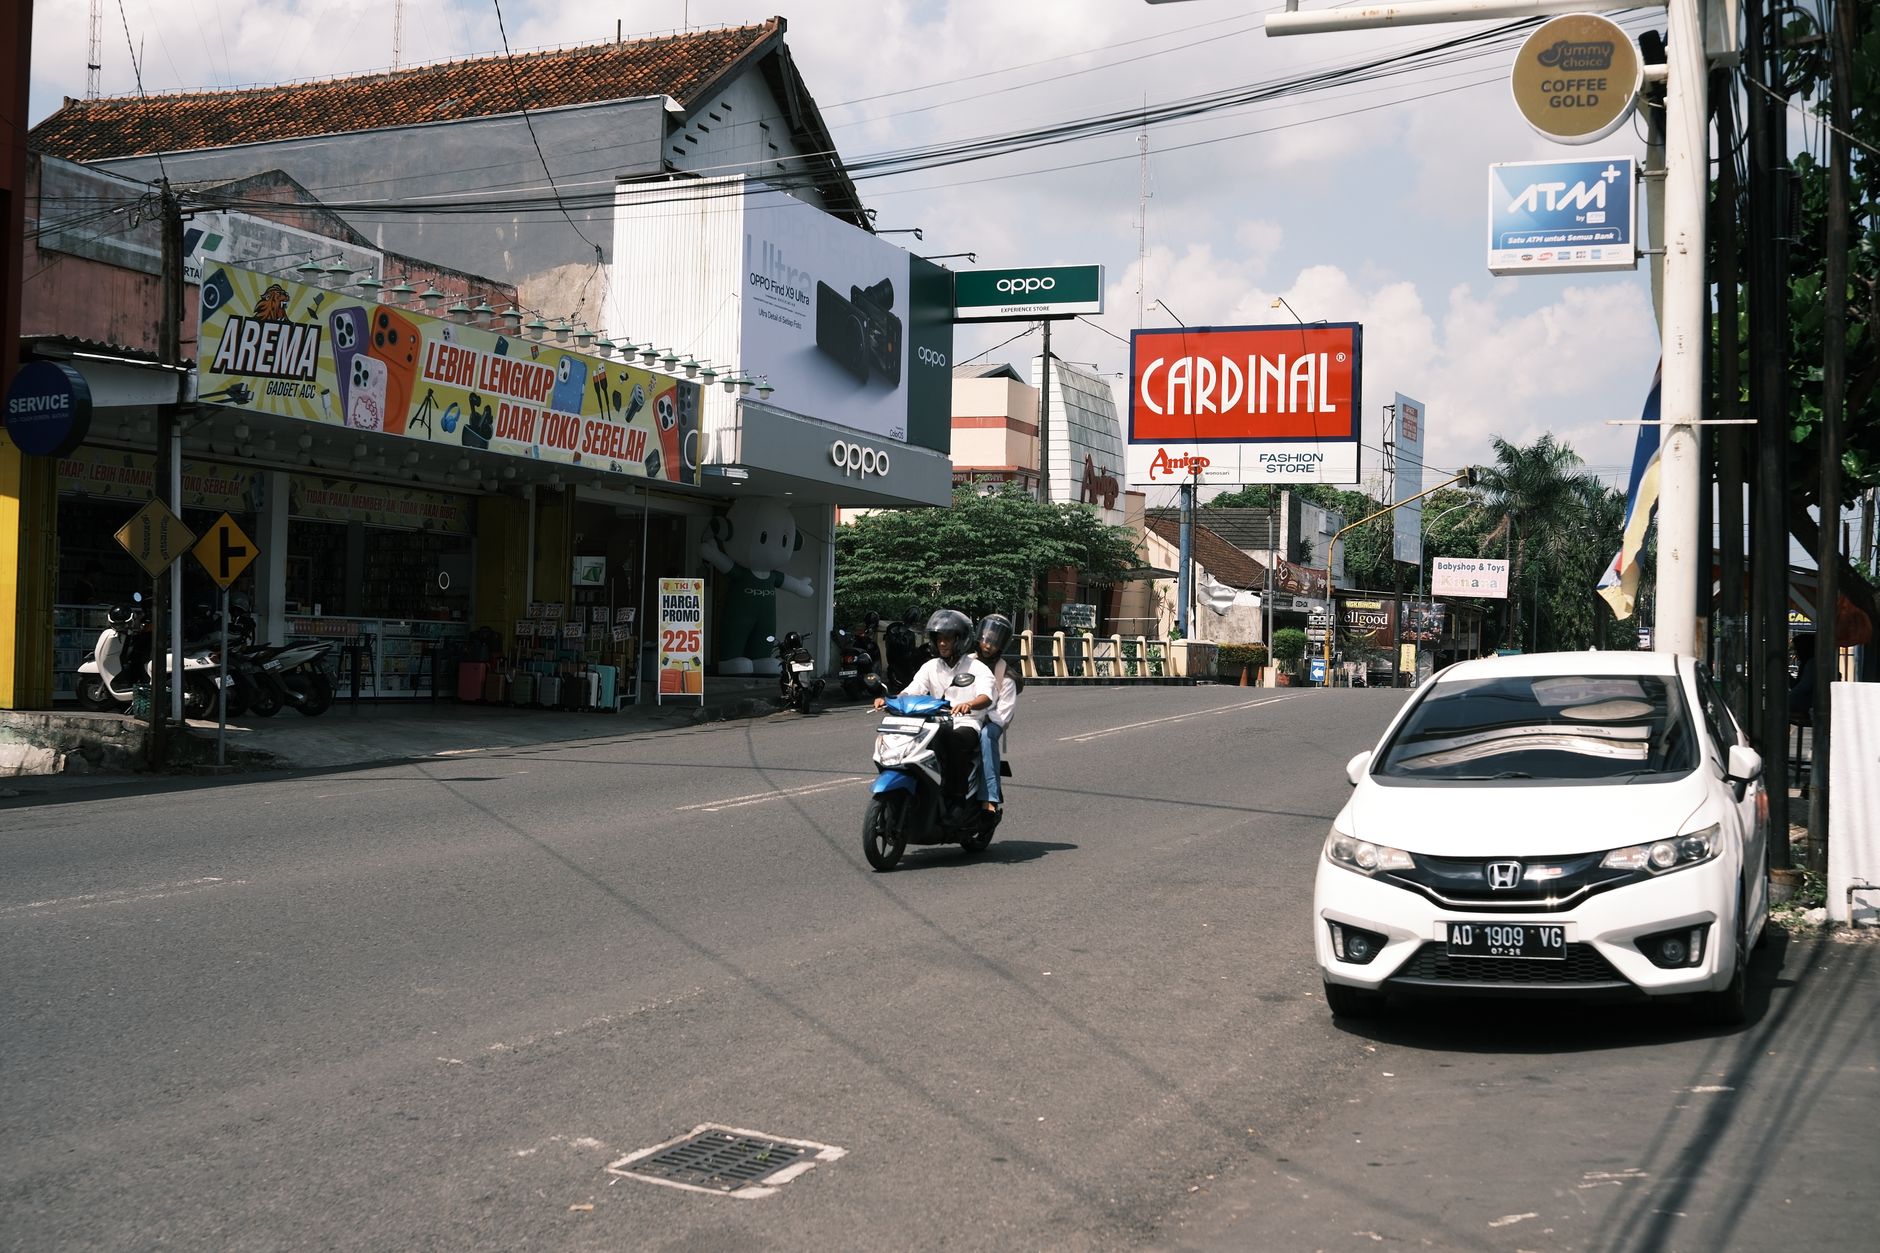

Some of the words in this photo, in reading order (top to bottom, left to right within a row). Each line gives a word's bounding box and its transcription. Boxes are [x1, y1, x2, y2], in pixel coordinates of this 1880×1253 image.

[1562, 57, 1604, 67] choice
[1540, 78, 1608, 93] COFFEE
[1549, 94, 1599, 108] GOLD
[1575, 215, 1585, 223] by
[1526, 235, 1542, 243] ATM
[1543, 234, 1566, 242] untuk
[1594, 232, 1615, 240] Bank
[749, 272, 770, 290] OPPO
[770, 280, 785, 296] Find
[785, 285, 795, 299] X9
[795, 290, 810, 305] Ultra
[996, 276, 1056, 295] oppo
[212, 316, 320, 380] AREMA
[917, 345, 946, 368] oppo
[423, 340, 478, 389] LEBIH
[478, 354, 556, 404] LENGKAP
[266, 380, 299, 399] GADGET
[299, 383, 316, 400] ACC
[1140, 352, 1336, 415] CARDINAL
[8, 393, 70, 414] SERVICE
[495, 402, 538, 443] DARI
[539, 411, 581, 450] TOKO
[582, 420, 648, 464] SEBELAH
[831, 439, 889, 478] oppo
[1149, 447, 1211, 481] Amigo
[1258, 452, 1324, 463] FASHION
[1266, 463, 1315, 473] STORE
[89, 464, 117, 481] LEBIH
[203, 478, 240, 497] SEBELAH
[1437, 561, 1476, 573] Babyshop
[1478, 563, 1485, 571] &
[1487, 563, 1505, 573] Toys
[662, 595, 699, 609] HARGA
[662, 609, 700, 622] PROMO
[1452, 925, 1473, 945] AD
[1484, 926, 1524, 946] 1909
[1539, 927, 1562, 948] VG
